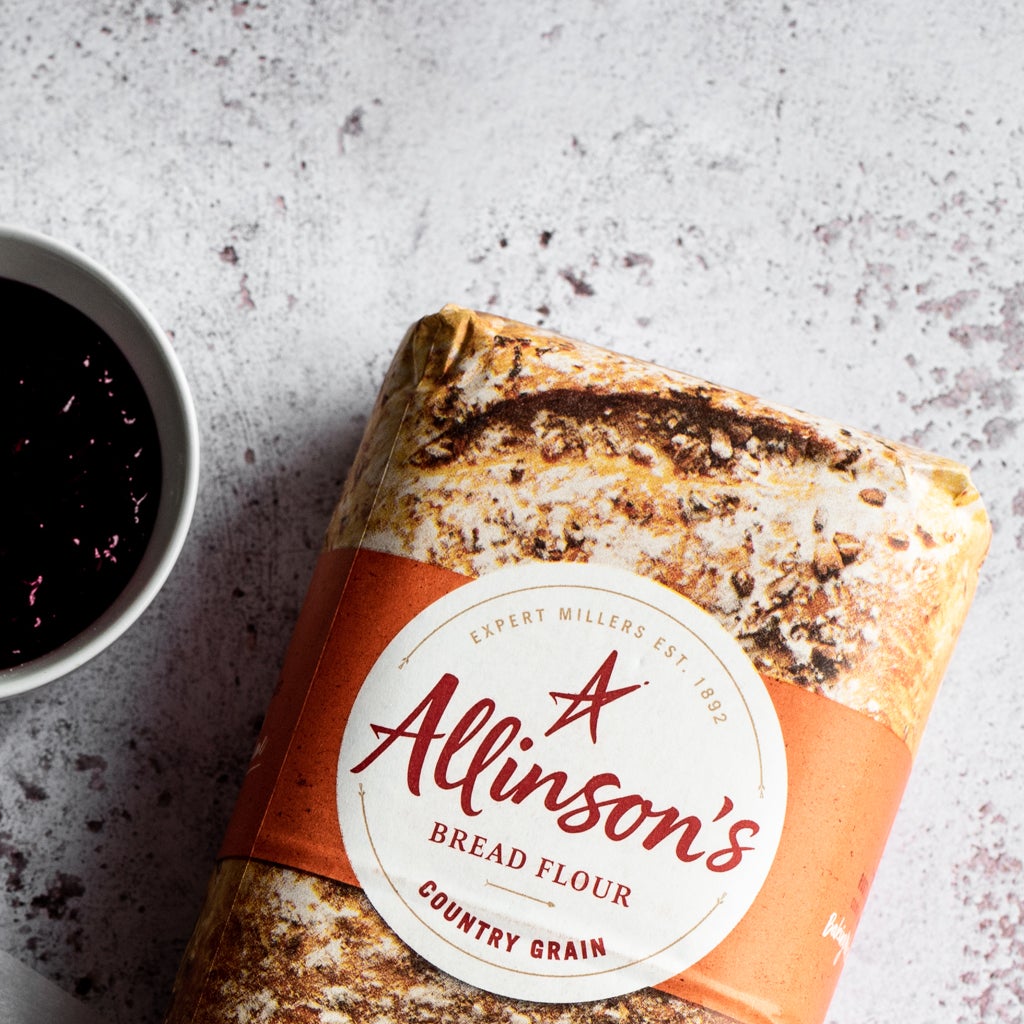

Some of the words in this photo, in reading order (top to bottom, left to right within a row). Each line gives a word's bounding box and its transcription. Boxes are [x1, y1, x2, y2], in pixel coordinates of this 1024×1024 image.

[469, 607, 545, 644] EXPERT
[559, 607, 646, 639] MILLERS
[653, 636, 688, 673] EST.
[694, 676, 727, 725] 1892
[350, 673, 761, 874] Allinson's
[428, 821, 528, 870] BREAD
[535, 857, 634, 908] FLOUR
[418, 879, 520, 953] COUNTRY
[529, 937, 607, 961] GRAIN
